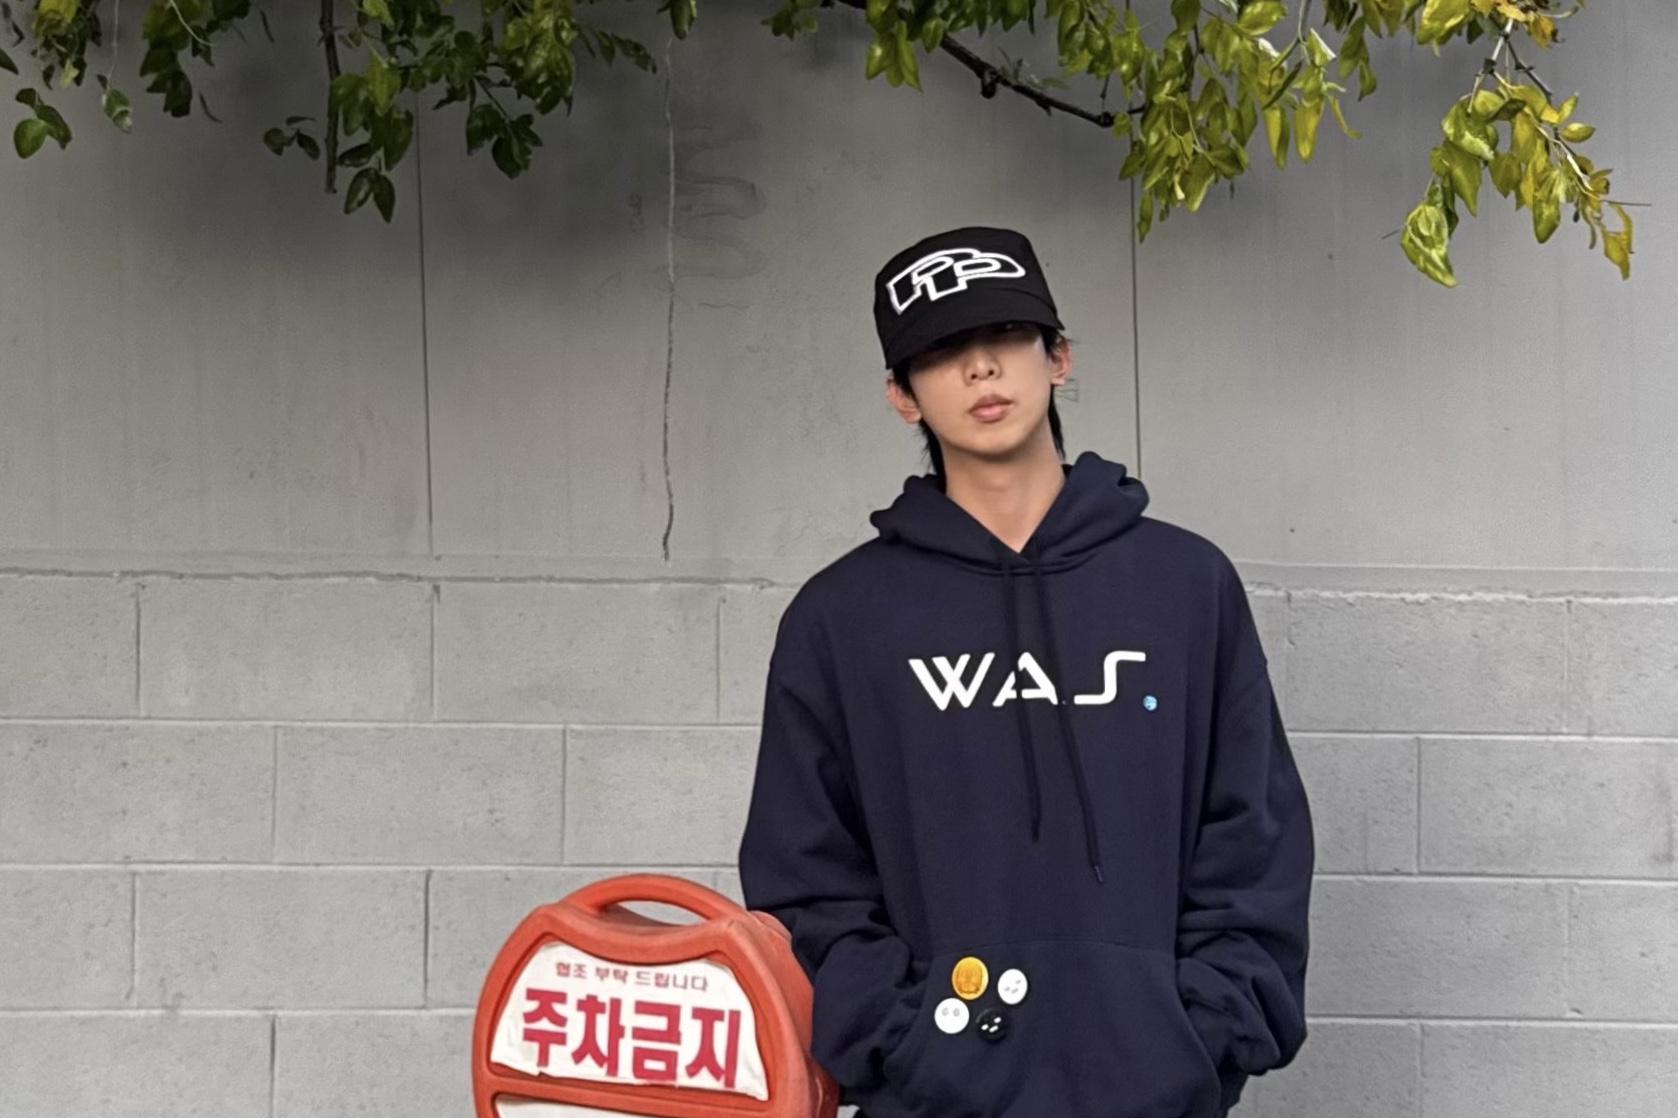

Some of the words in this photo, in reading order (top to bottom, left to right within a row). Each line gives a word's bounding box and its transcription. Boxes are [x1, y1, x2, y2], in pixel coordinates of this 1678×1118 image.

[556, 962, 588, 979] 협조
[595, 966, 629, 985] 부탁
[634, 970, 709, 993] 드립니다
[522, 987, 742, 1089] 주차금지
